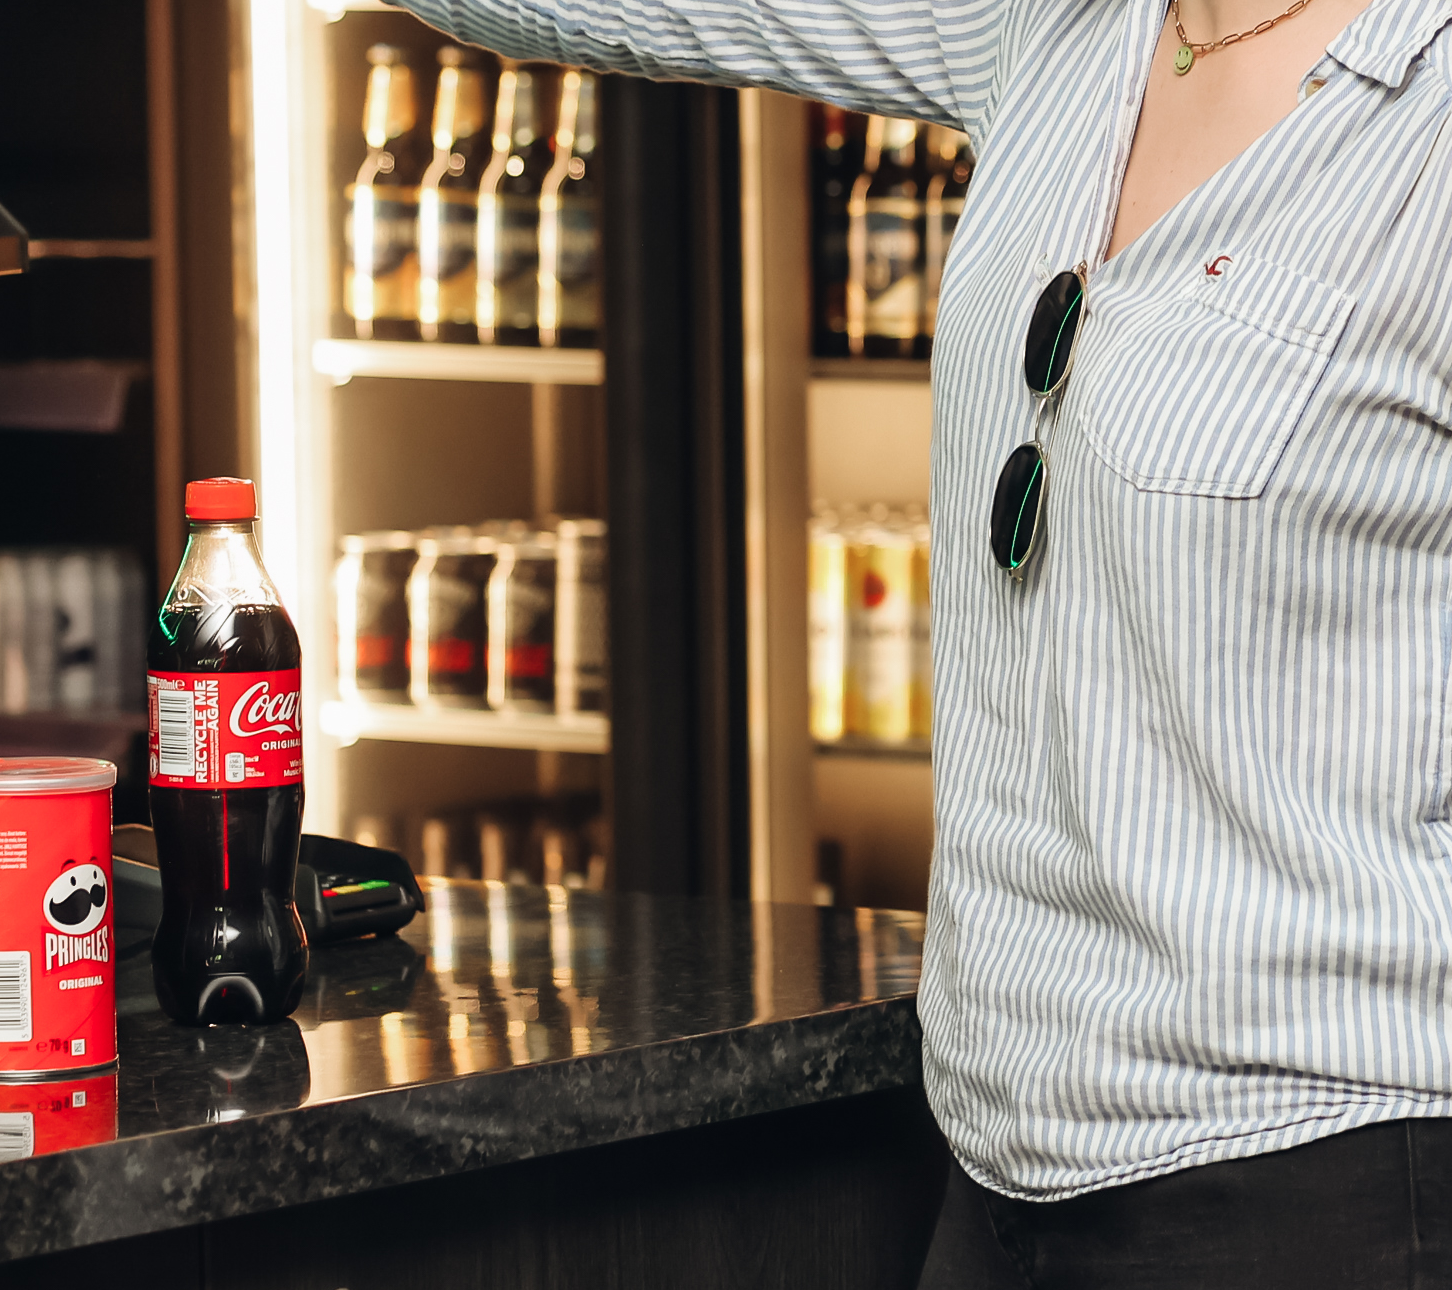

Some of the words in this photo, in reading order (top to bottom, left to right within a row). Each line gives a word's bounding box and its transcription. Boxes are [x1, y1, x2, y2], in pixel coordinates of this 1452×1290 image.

[193, 680, 207, 706] ME
[206, 680, 219, 731] AGAIN
[194, 708, 208, 783] RECYCLE
[45, 925, 109, 971] PRINGLES
[58, 975, 104, 990] ORIGINAL
